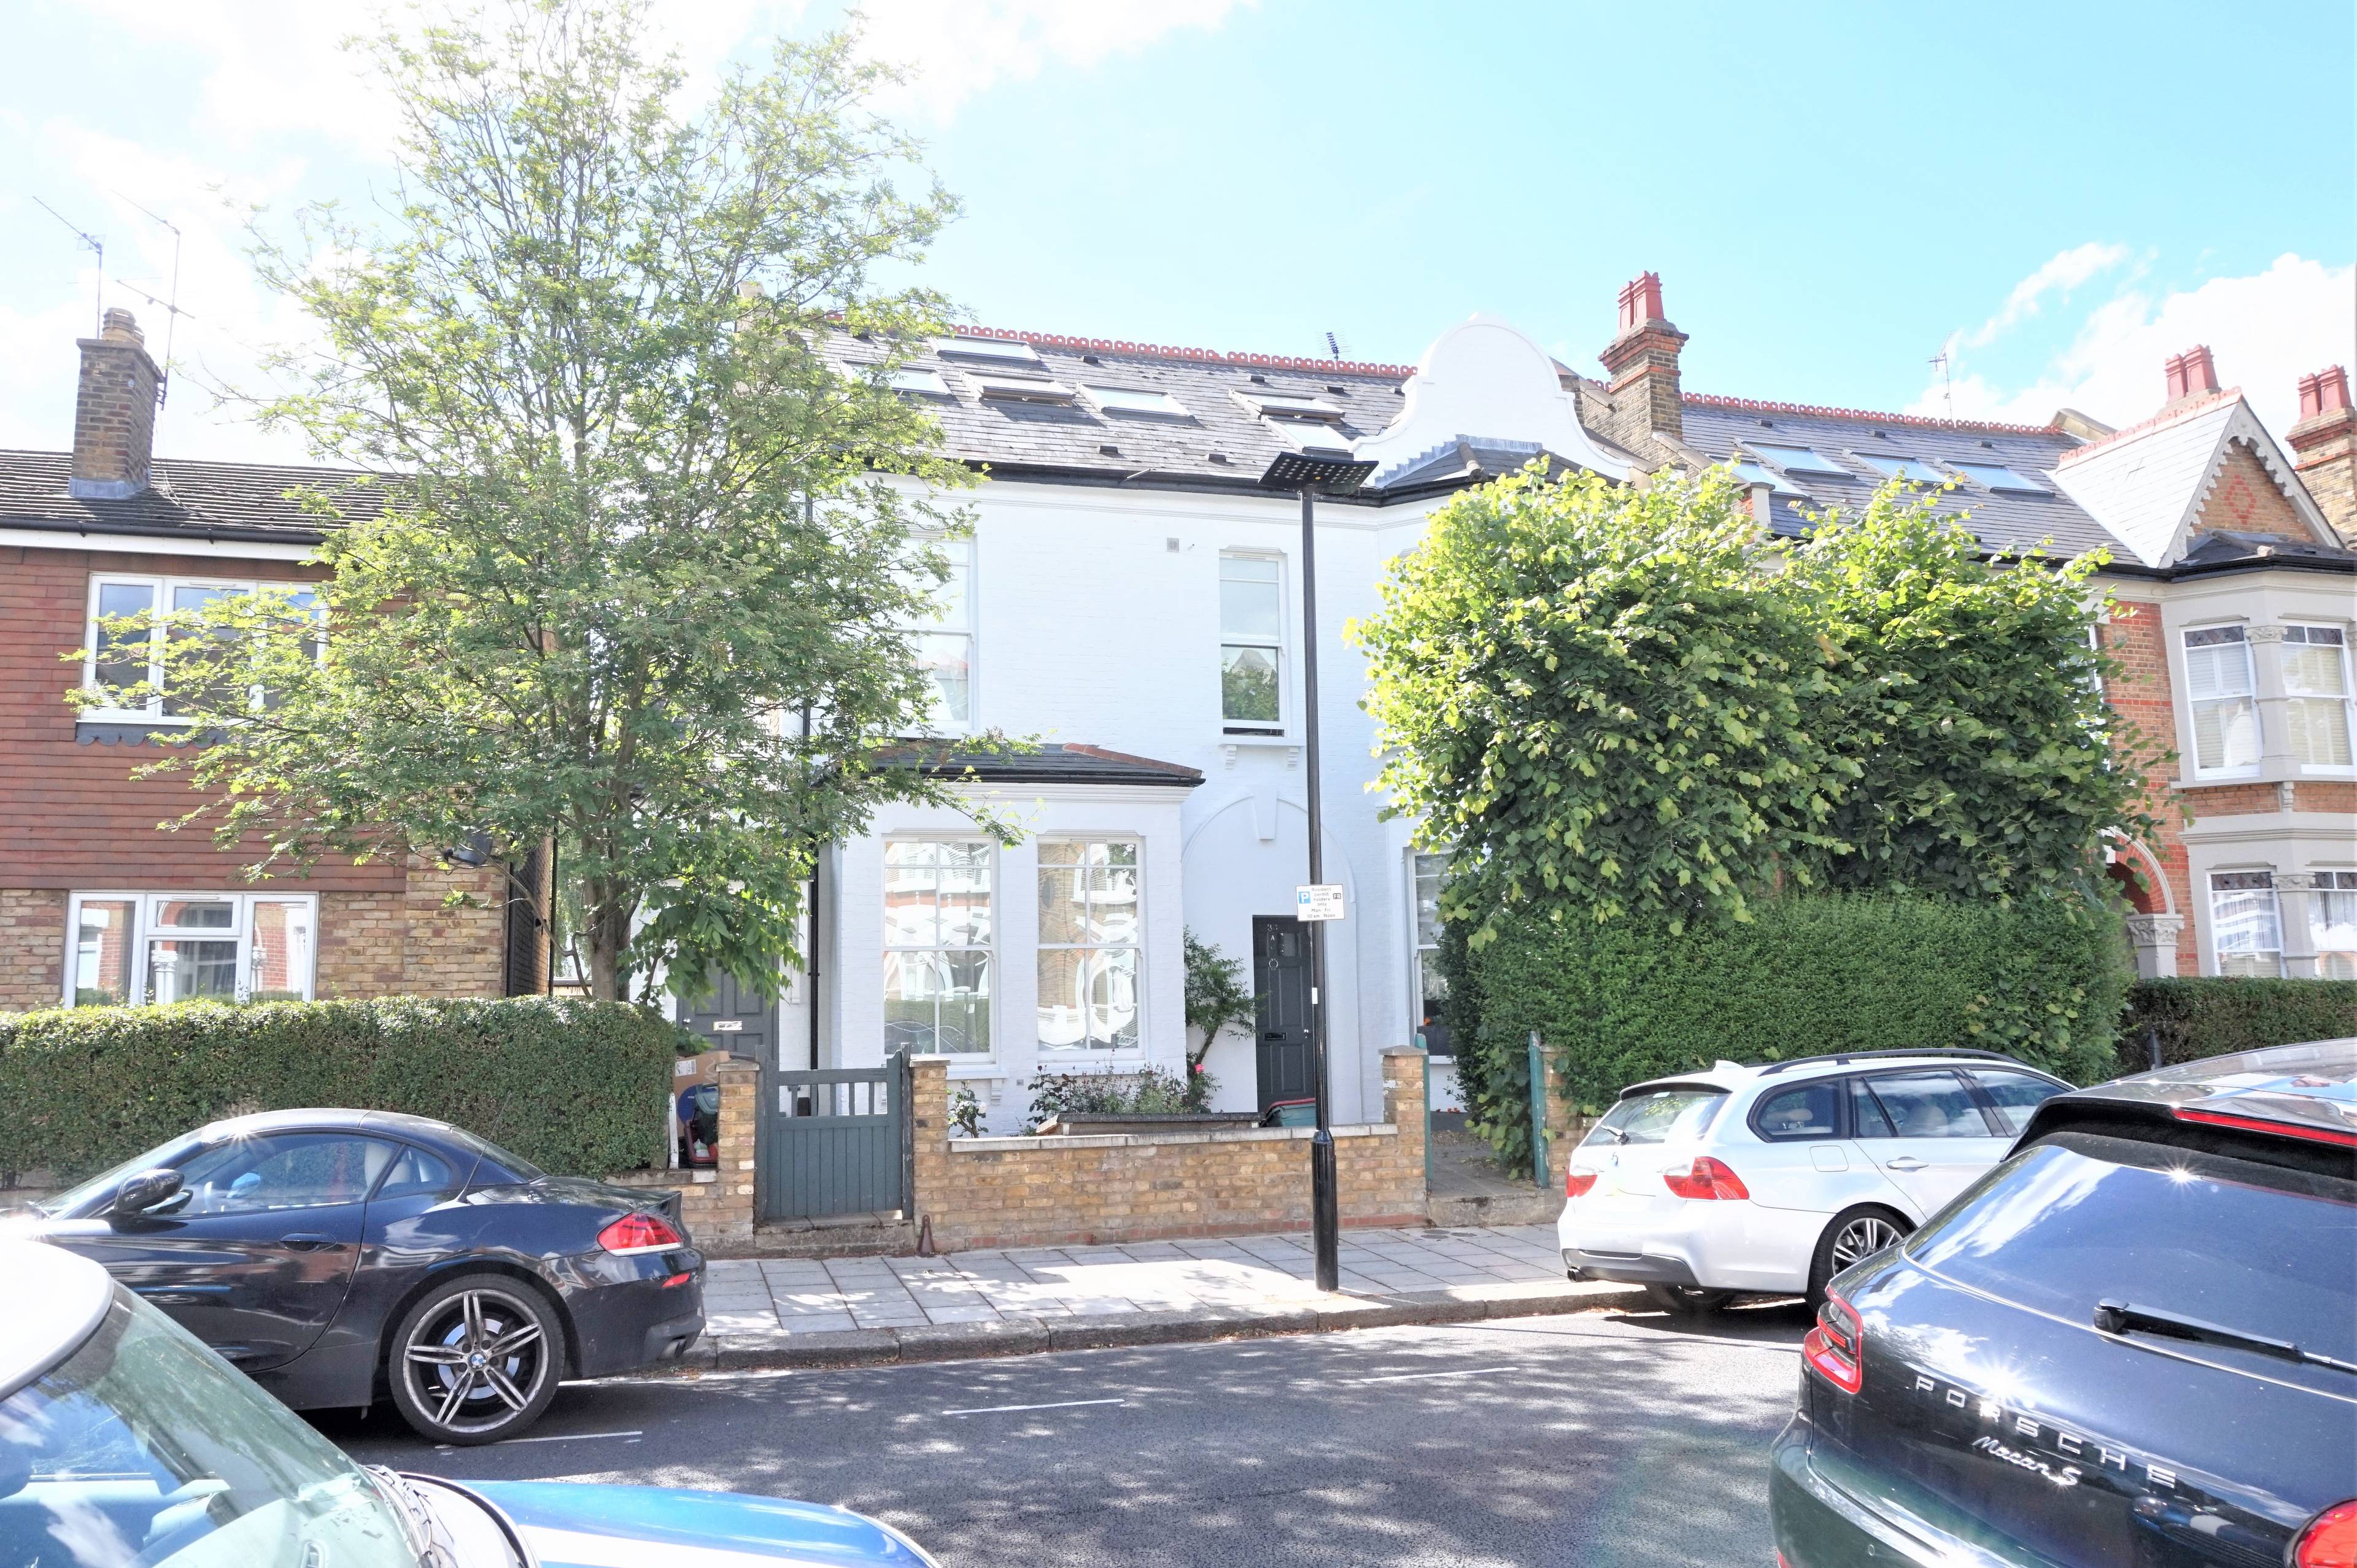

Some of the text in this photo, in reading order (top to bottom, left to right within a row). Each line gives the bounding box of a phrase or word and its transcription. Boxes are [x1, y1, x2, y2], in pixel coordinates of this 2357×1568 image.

[1301, 892, 1309, 903] P
[1916, 1375, 2176, 1489] PORSCHE
[1971, 1435, 2083, 1486] Macan S
